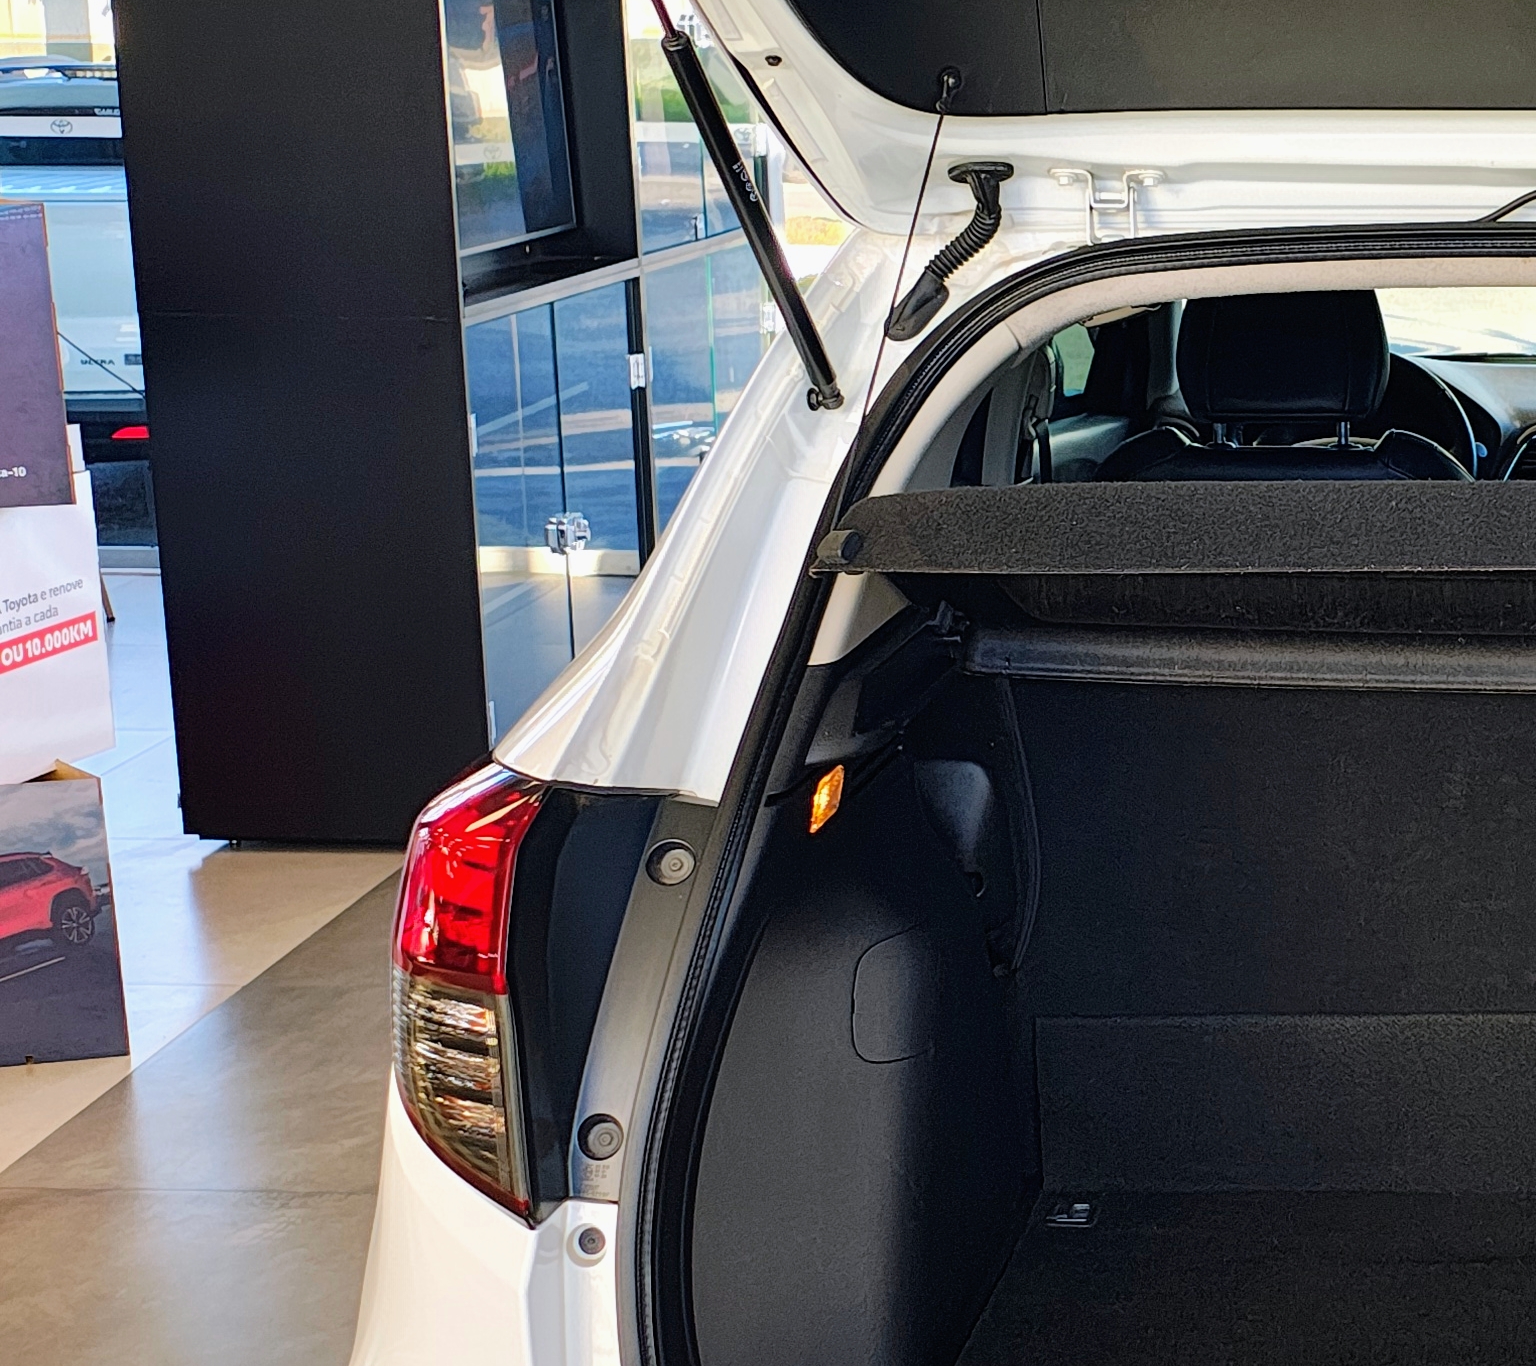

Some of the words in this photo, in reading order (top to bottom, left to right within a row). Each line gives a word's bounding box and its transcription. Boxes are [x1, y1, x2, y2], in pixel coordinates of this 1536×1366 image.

[0, 466, 26, 478] a-10
[2, 592, 39, 613] Toyota
[40, 590, 47, 600] e
[48, 578, 83, 598] renove
[25, 616, 31, 626] a
[34, 604, 59, 623] cada
[1, 642, 24, 666] OU
[26, 619, 93, 658] 10.000KM
